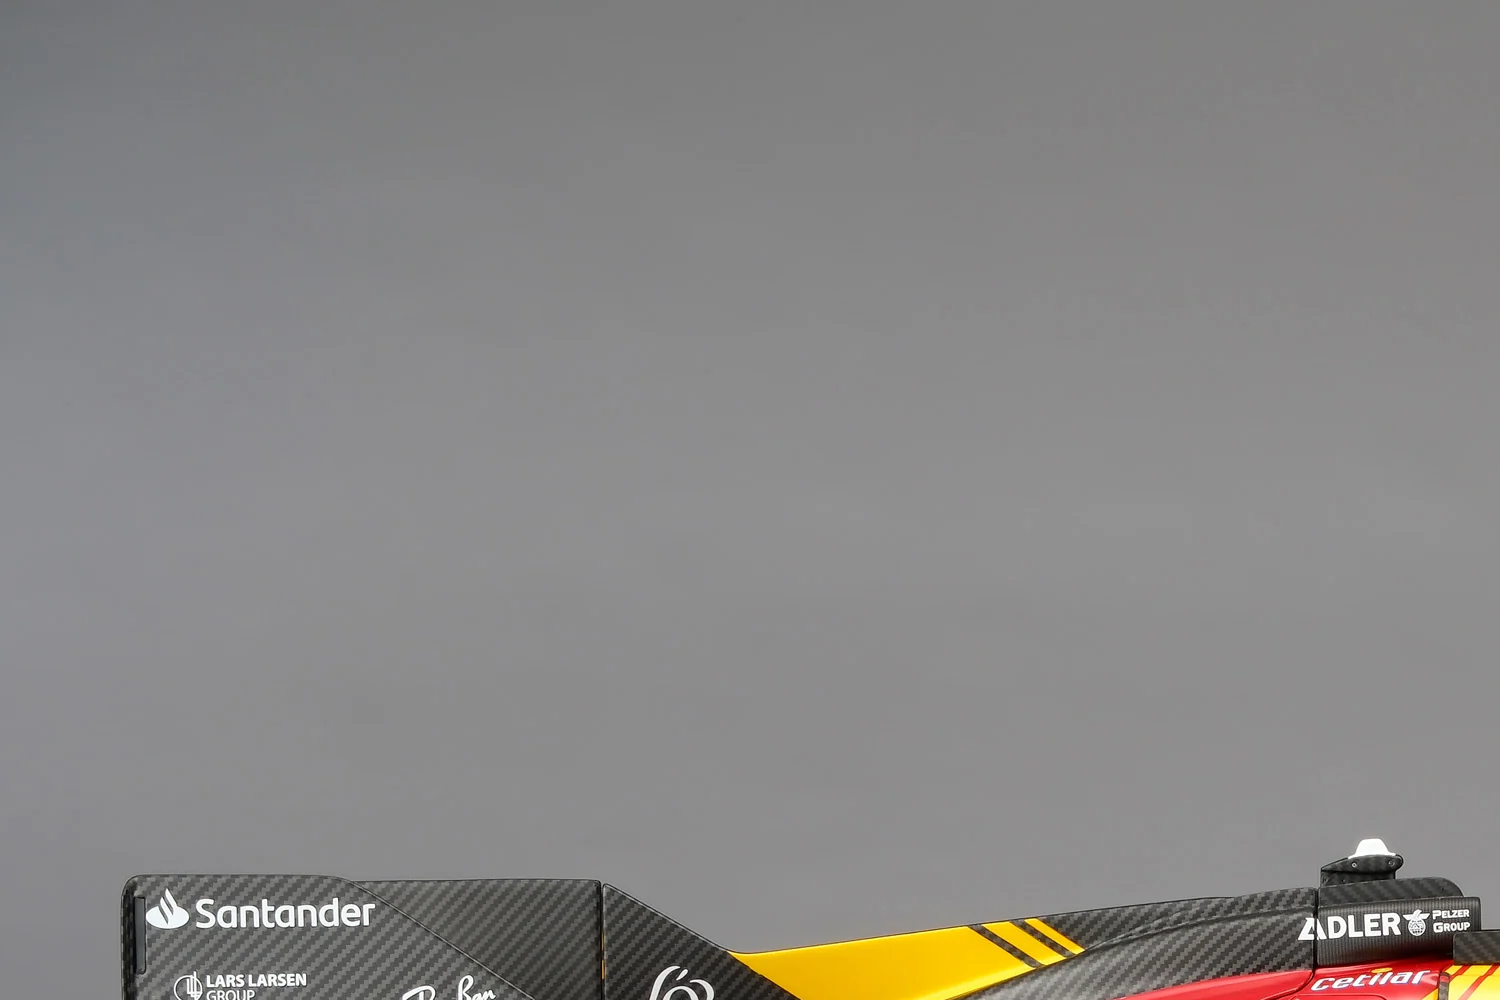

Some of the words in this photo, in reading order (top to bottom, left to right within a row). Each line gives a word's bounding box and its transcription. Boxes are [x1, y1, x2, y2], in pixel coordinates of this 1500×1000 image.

[195, 897, 376, 929] Santander
[1432, 909, 1470, 920] PELZER
[1298, 912, 1402, 941] ADLER
[1433, 921, 1471, 933] GROUP
[206, 973, 245, 988] LARS
[248, 973, 307, 987] LARSEN
